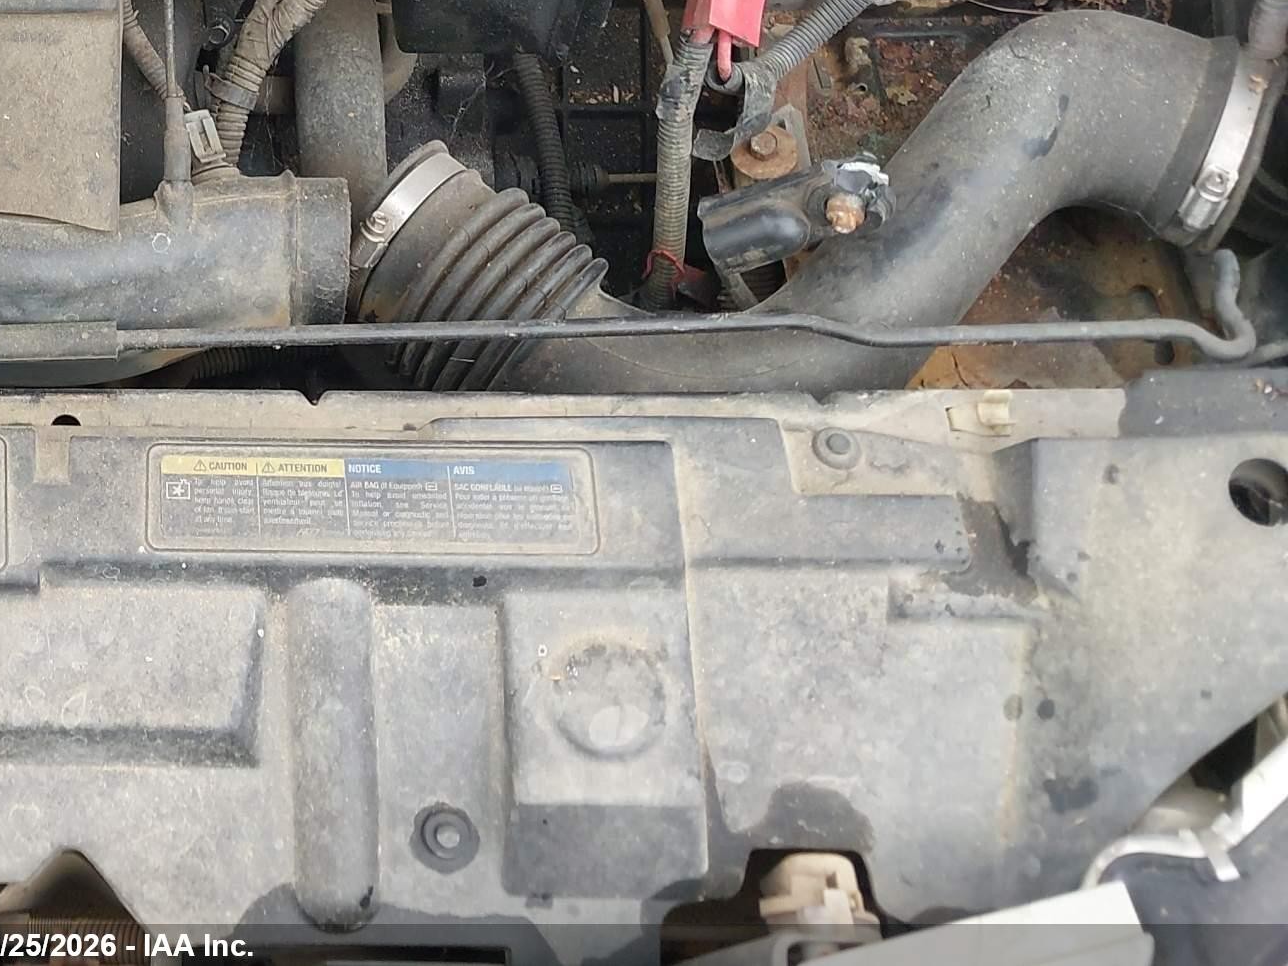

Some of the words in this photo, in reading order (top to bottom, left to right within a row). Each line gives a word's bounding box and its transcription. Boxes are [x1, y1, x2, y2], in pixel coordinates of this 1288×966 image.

[209, 460, 248, 472] CAUTION
[278, 462, 328, 474] ATTENTION
[348, 464, 382, 474] NOTICE
[453, 465, 475, 476] AVIS
[364, 481, 379, 491] BAG
[454, 483, 469, 493] SAC
[365, 491, 381, 500] help
